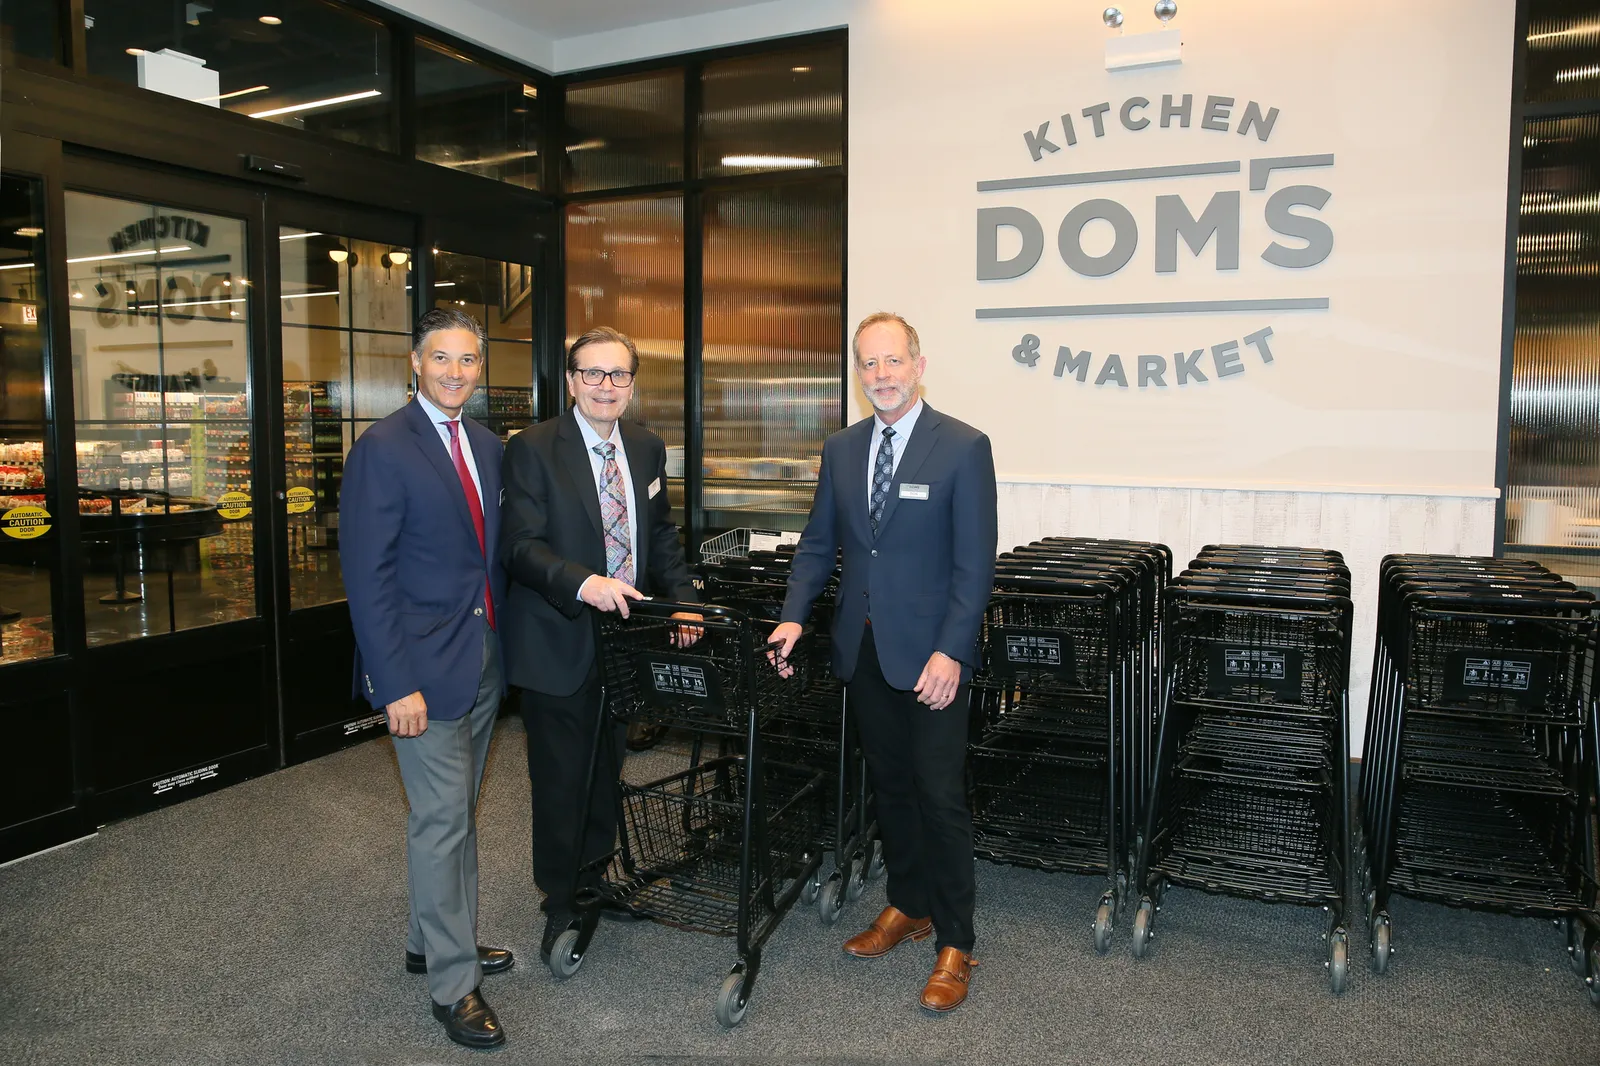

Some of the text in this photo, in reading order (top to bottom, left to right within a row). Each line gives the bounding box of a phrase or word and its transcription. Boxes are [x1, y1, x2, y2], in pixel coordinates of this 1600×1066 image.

[1023, 94, 1280, 162] KITCHEN
[976, 156, 1335, 280] DOM'S
[25, 304, 36, 318] EX
[1012, 326, 1274, 387] & MARKET
